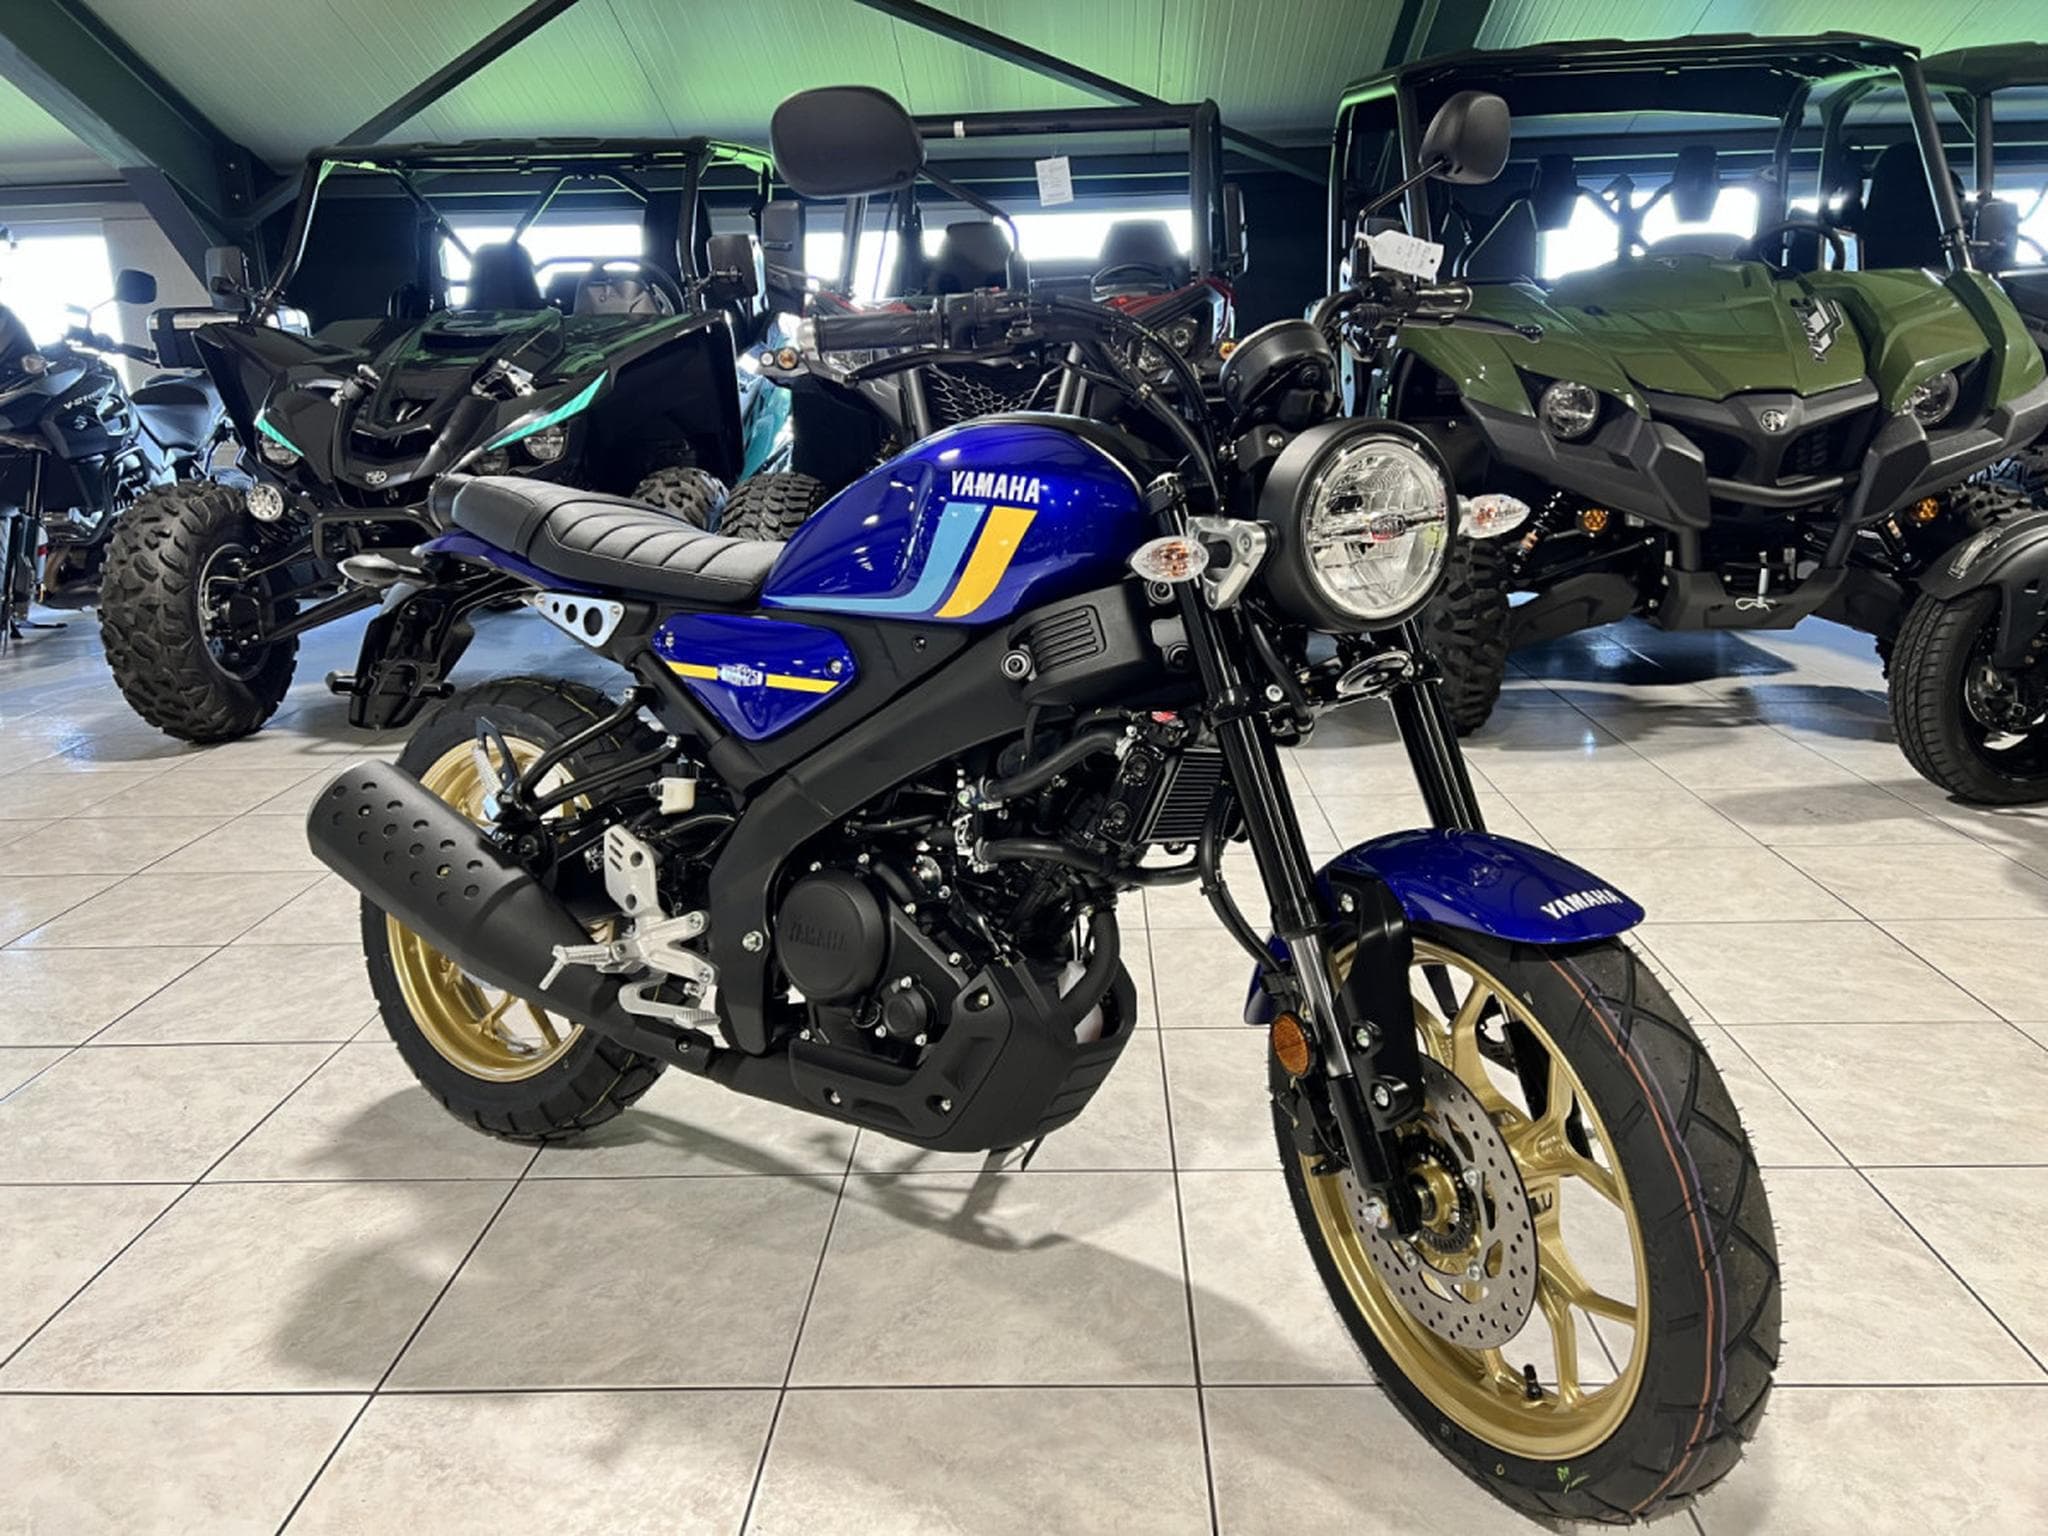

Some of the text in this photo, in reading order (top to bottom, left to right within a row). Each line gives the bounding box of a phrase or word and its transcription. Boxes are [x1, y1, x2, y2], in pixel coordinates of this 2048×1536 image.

[63, 387, 105, 410] V-ST
[951, 470, 1040, 504] YAMAHA
[1540, 889, 1623, 920] YAMAHA
[788, 919, 849, 952] YAMAHA
